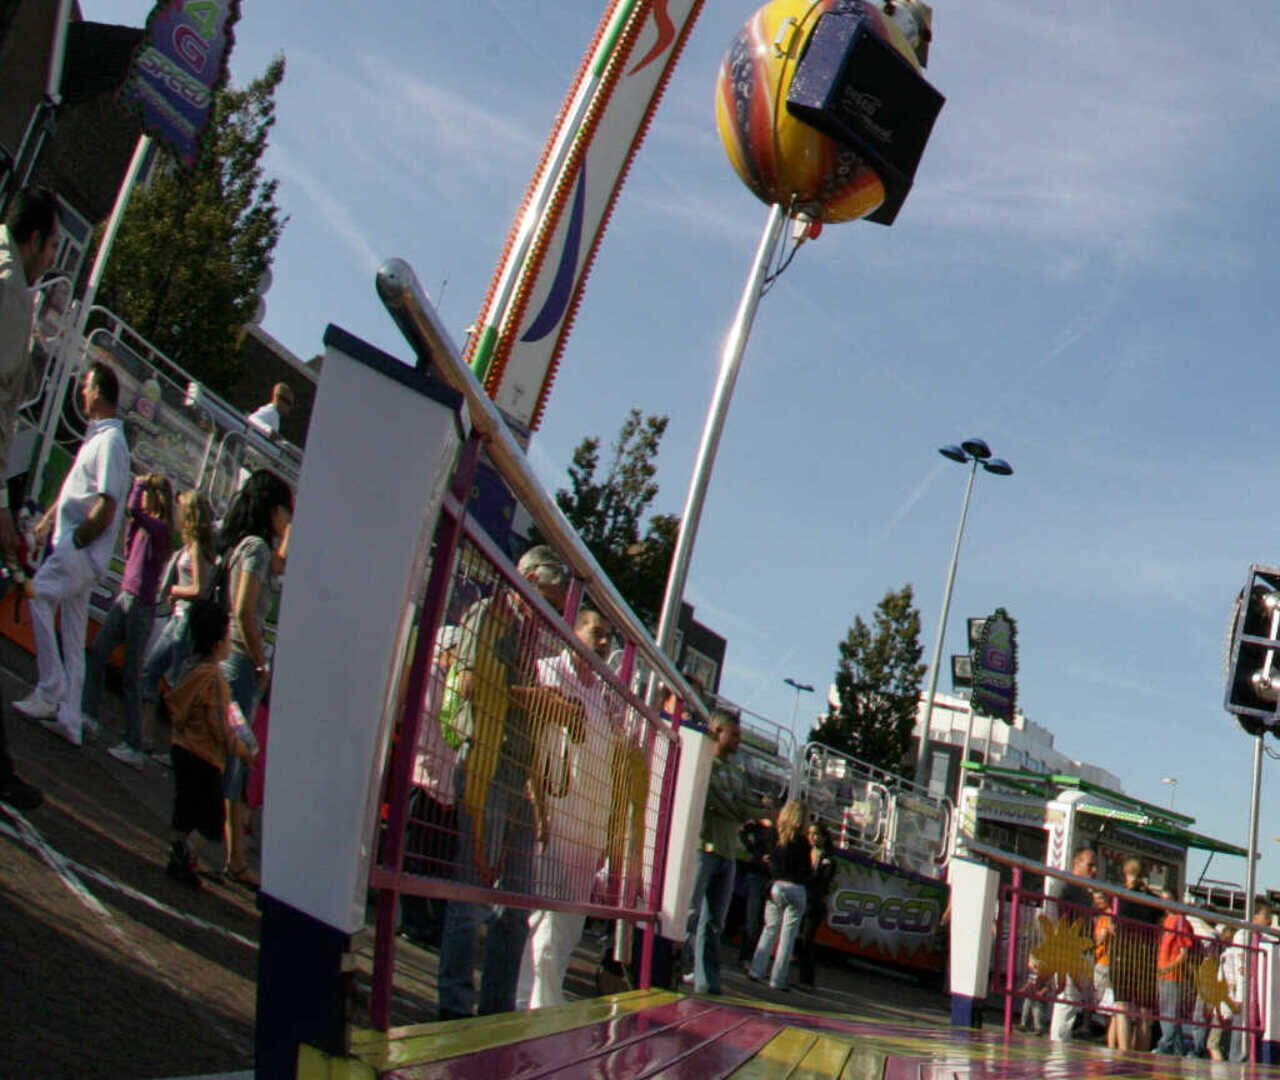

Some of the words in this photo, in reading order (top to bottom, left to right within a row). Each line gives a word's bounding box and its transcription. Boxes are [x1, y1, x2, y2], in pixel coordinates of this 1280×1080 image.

[184, 0, 221, 38] 4
[172, 24, 210, 74] G
[829, 890, 938, 935] SPEED
